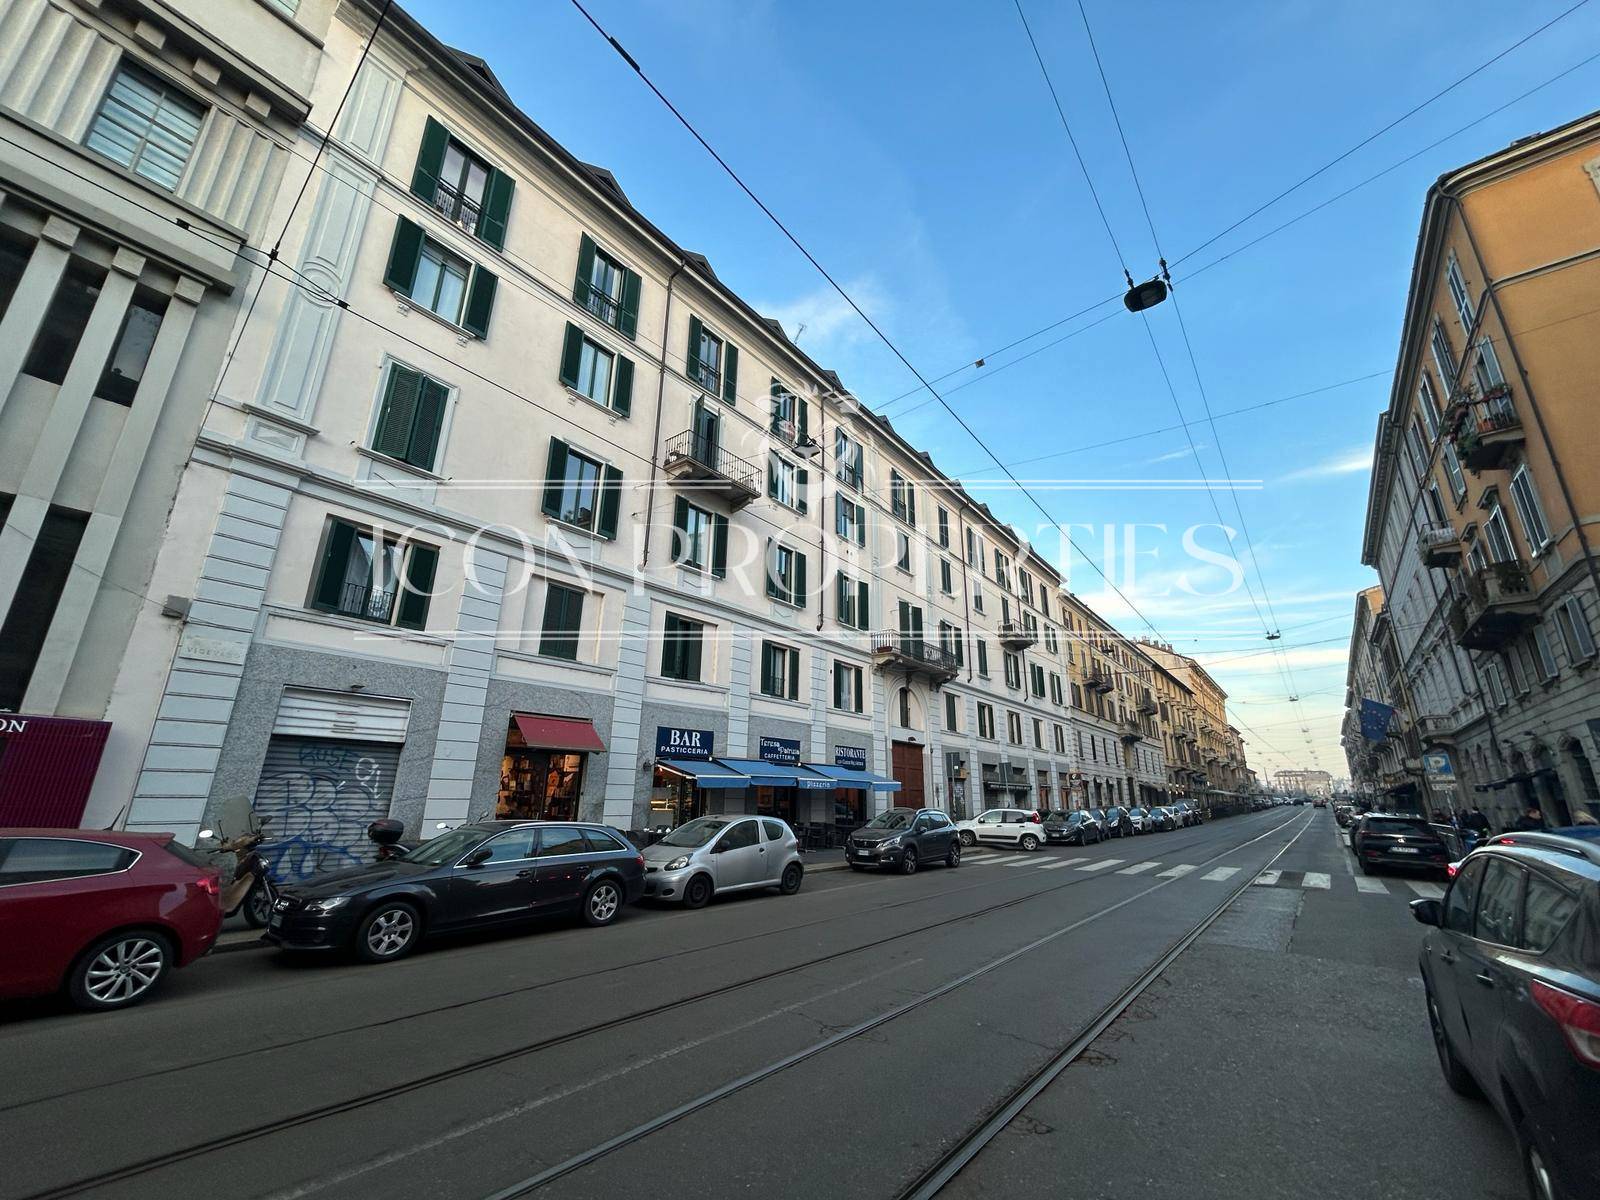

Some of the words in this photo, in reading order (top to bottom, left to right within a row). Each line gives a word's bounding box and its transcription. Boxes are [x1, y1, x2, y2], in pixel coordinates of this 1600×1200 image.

[670, 729, 701, 747] BAR
[660, 745, 708, 755] PASTICCERIA
[763, 752, 795, 760] CAFFETTERIA
[835, 746, 866, 760] RISTORANTE
